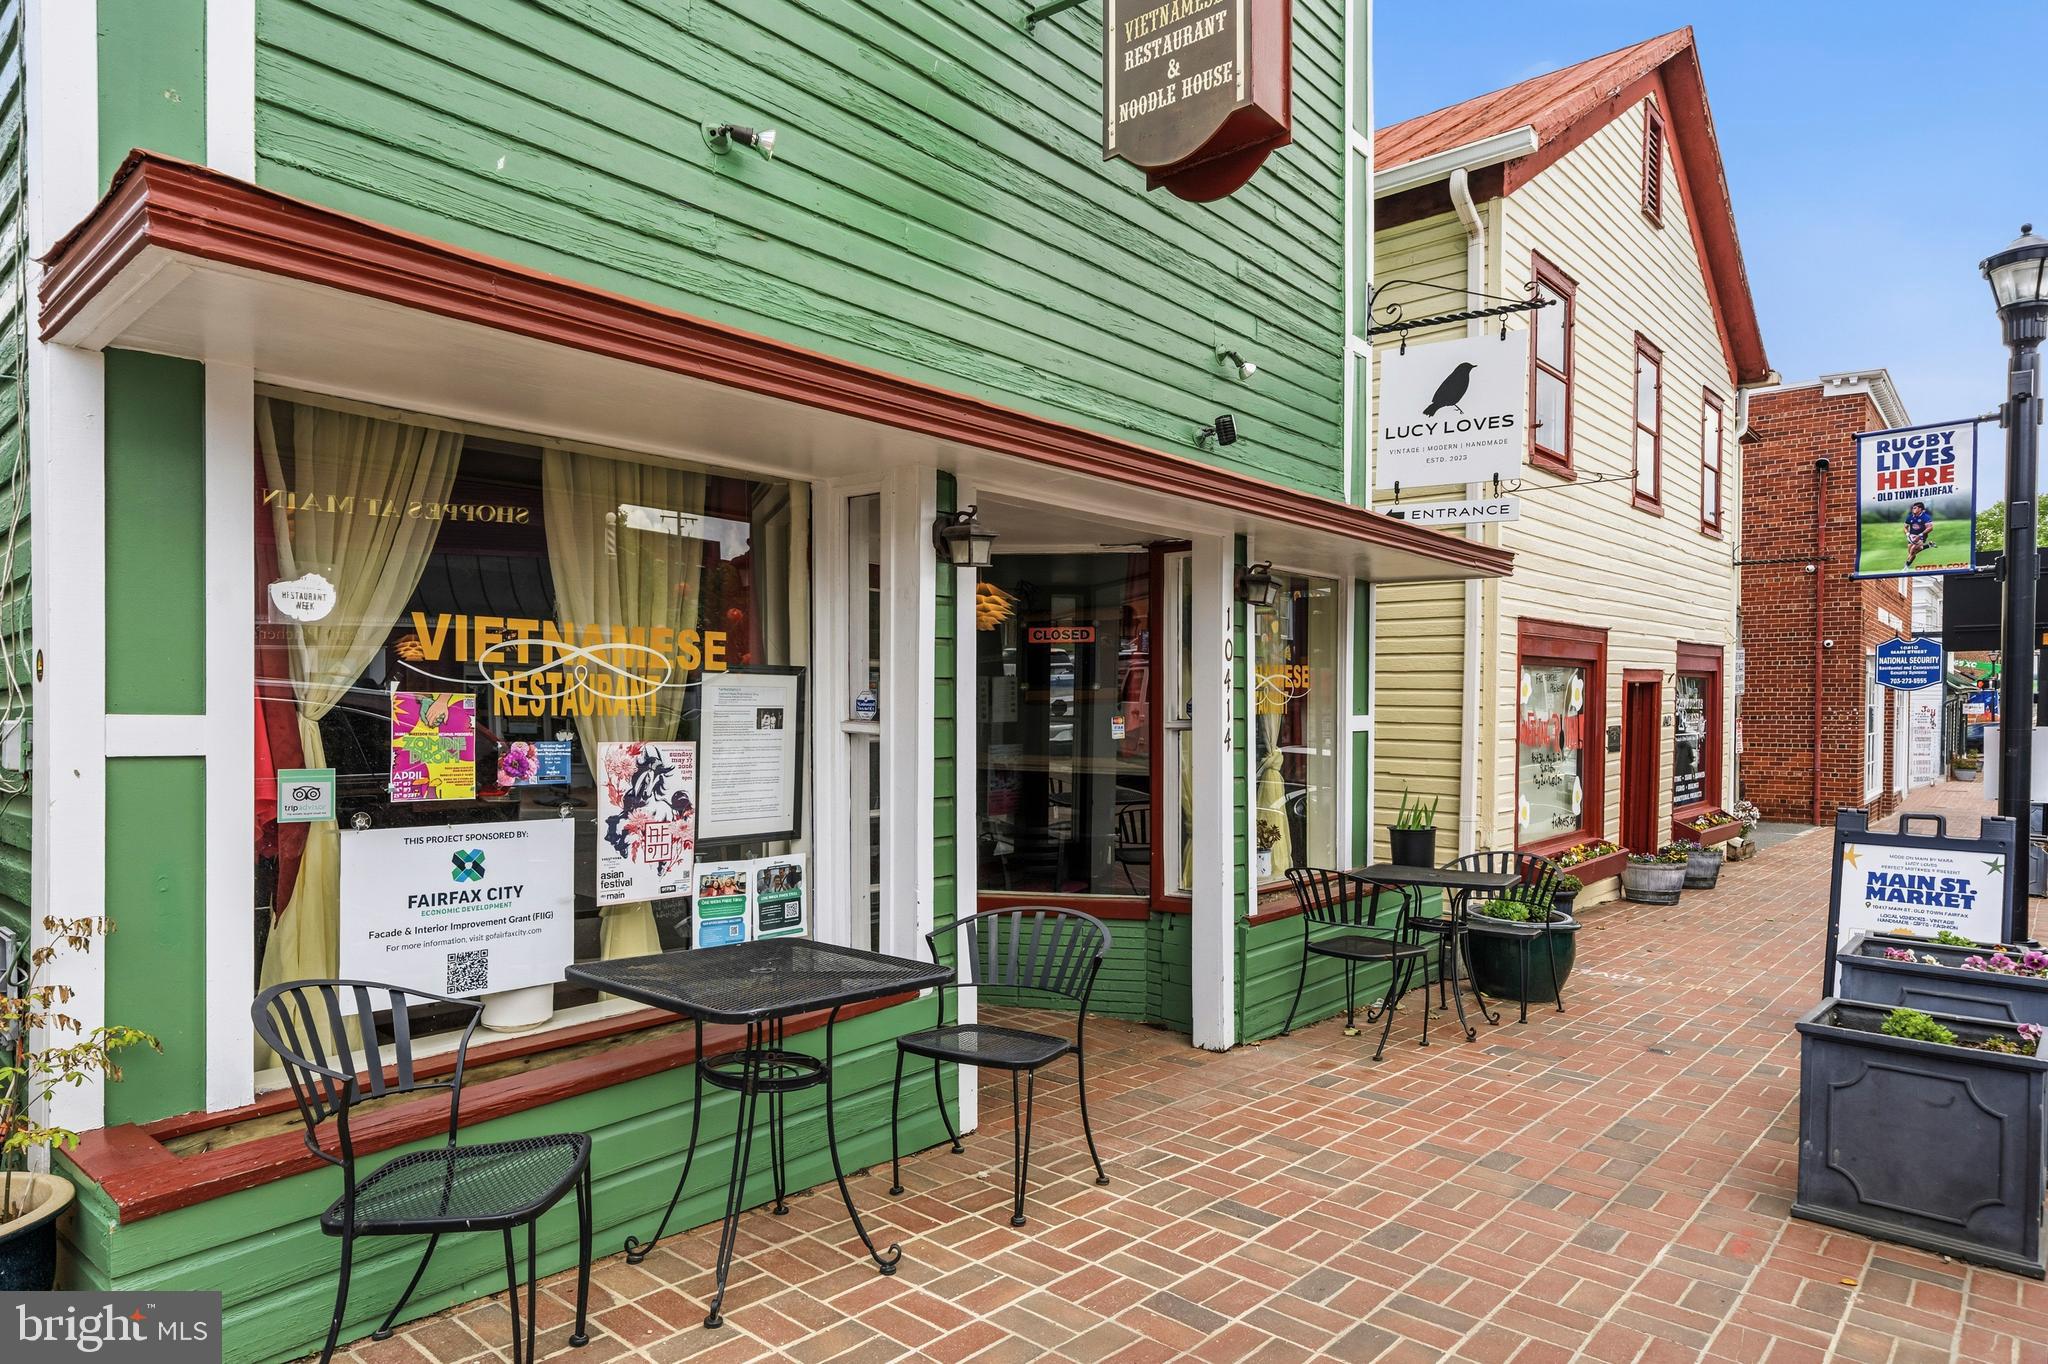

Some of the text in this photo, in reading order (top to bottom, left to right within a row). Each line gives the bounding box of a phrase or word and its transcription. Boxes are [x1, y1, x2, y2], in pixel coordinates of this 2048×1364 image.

[1124, 0, 1222, 43] VIETNAME
[1124, 10, 1227, 72] RESTAURANT
[1167, 58, 1181, 79] &
[1118, 61, 1233, 124] NOODLE HOUSE
[1386, 414, 1514, 440] LUCY LOVES
[1389, 447, 1420, 455] VINTAGE
[1465, 438, 1508, 448] HANDMADE
[1876, 431, 1956, 454] RUGBY
[1876, 445, 1956, 472] LIVES
[1877, 464, 1955, 491] HERE
[1877, 485, 1953, 502] OLD TOWN FAIRFAX
[1411, 504, 1511, 520] ENTRANCE
[411, 611, 728, 671] VIETNAMESE
[1033, 629, 1090, 641] CLOSED
[1879, 656, 1940, 665] NATIONAL SECURITY
[493, 670, 660, 717] RESTAURANT
[393, 771, 425, 780] APRIL
[404, 830, 529, 845] THIS PROJECT SPONSORED BY:
[600, 870, 624, 880] asian
[600, 878, 633, 889] festival
[1867, 871, 1978, 895] MAIN ST.
[408, 884, 524, 909] FAIRFAX CITY
[606, 891, 625, 900] main
[1865, 886, 1975, 910] MARKET
[421, 901, 512, 917] ECONOMIC DEVELOPMENT
[1945, 911, 1969, 919] FAIRFAX
[368, 910, 554, 939] Facade & Interior Improvement Grant (FIIG)
[386, 944, 399, 952] For
[423, 936, 468, 948] information,
[469, 934, 484, 943] visit
[485, 927, 542, 941] gofairfaxcity.com
